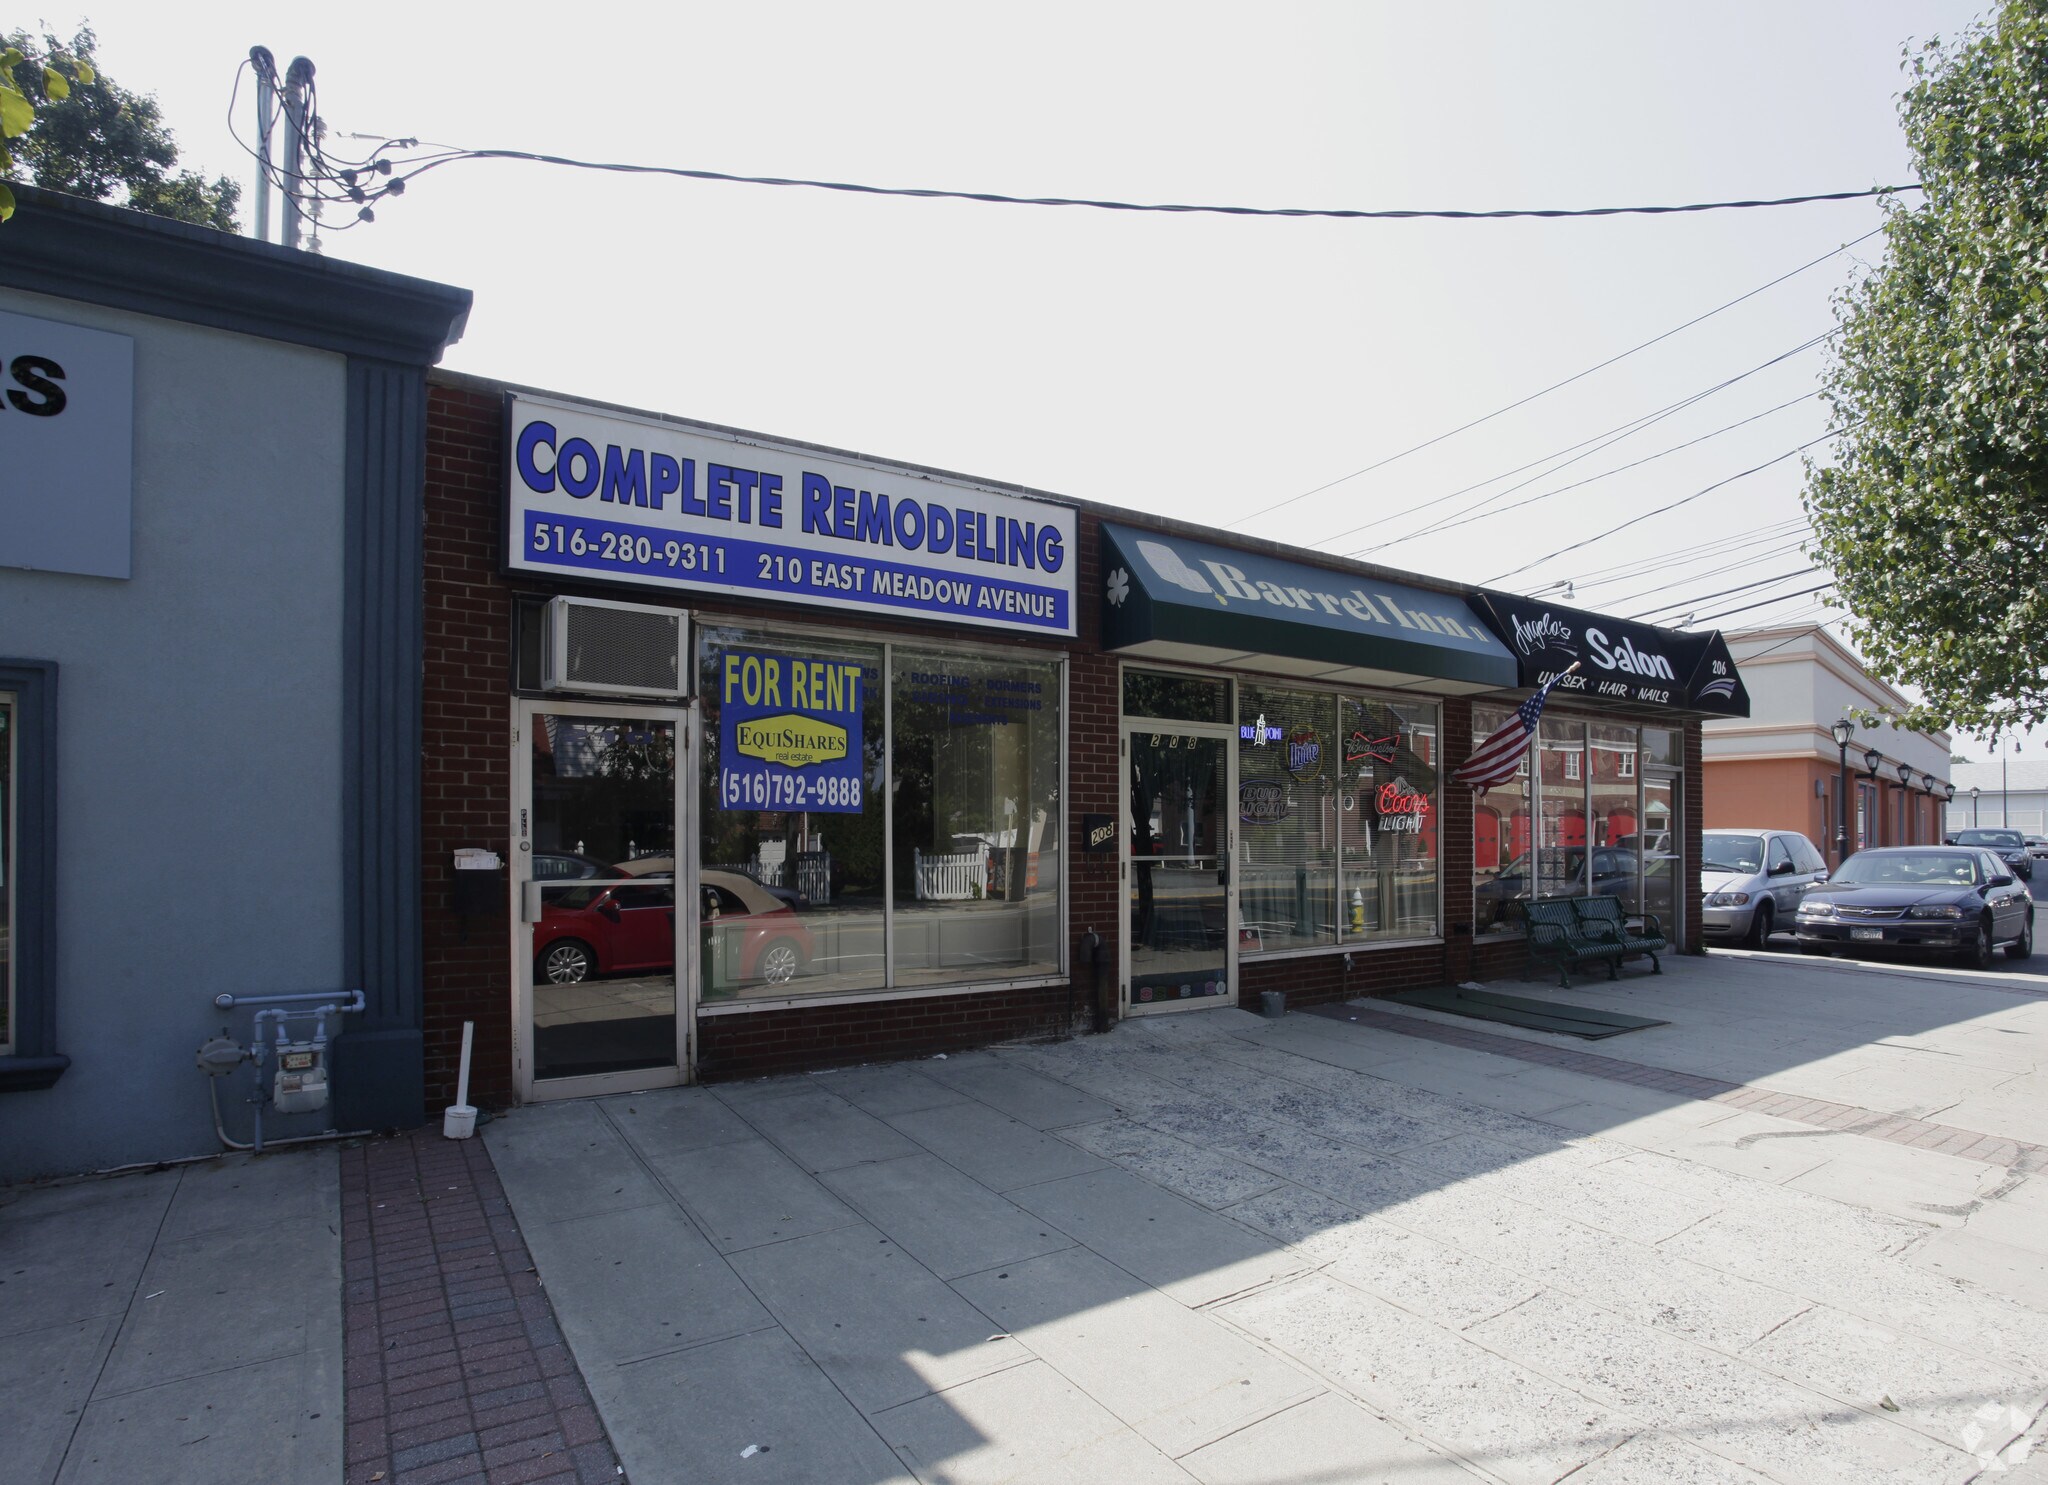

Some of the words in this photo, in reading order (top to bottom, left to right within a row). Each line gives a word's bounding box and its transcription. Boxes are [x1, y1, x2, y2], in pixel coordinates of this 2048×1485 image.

[0, 355, 67, 417] S
[516, 420, 783, 529] COMPLETE
[801, 470, 1065, 574] REMODELING
[532, 522, 727, 575] 516-280-9311
[757, 553, 802, 584] 210
[810, 561, 866, 593] EAST
[871, 569, 973, 608] MEADOW
[976, 586, 1056, 620] AVENUE
[1199, 558, 1391, 626] Barrel
[1377, 594, 1472, 640] Inn
[1511, 612, 1572, 656] Angelo's
[1585, 627, 1675, 681] Salon
[911, 672, 970, 689] ROOFING
[986, 679, 1042, 695] DORMERS
[1712, 660, 1727, 675] 206
[724, 655, 782, 707] FOR
[791, 662, 861, 713] RENT
[1537, 671, 1588, 690] UNSEX
[1598, 681, 1628, 697] HAIR
[1637, 687, 1669, 704] NAILS
[1240, 725, 1256, 740] BLUE
[775, 752, 789, 762] real
[790, 753, 813, 763] estate
[721, 768, 861, 808] (516)792-9888
[1243, 787, 1282, 802] BUD
[1379, 783, 1430, 814] Coors
[1092, 824, 1113, 845] 208
[1383, 815, 1427, 831] LIGHT
